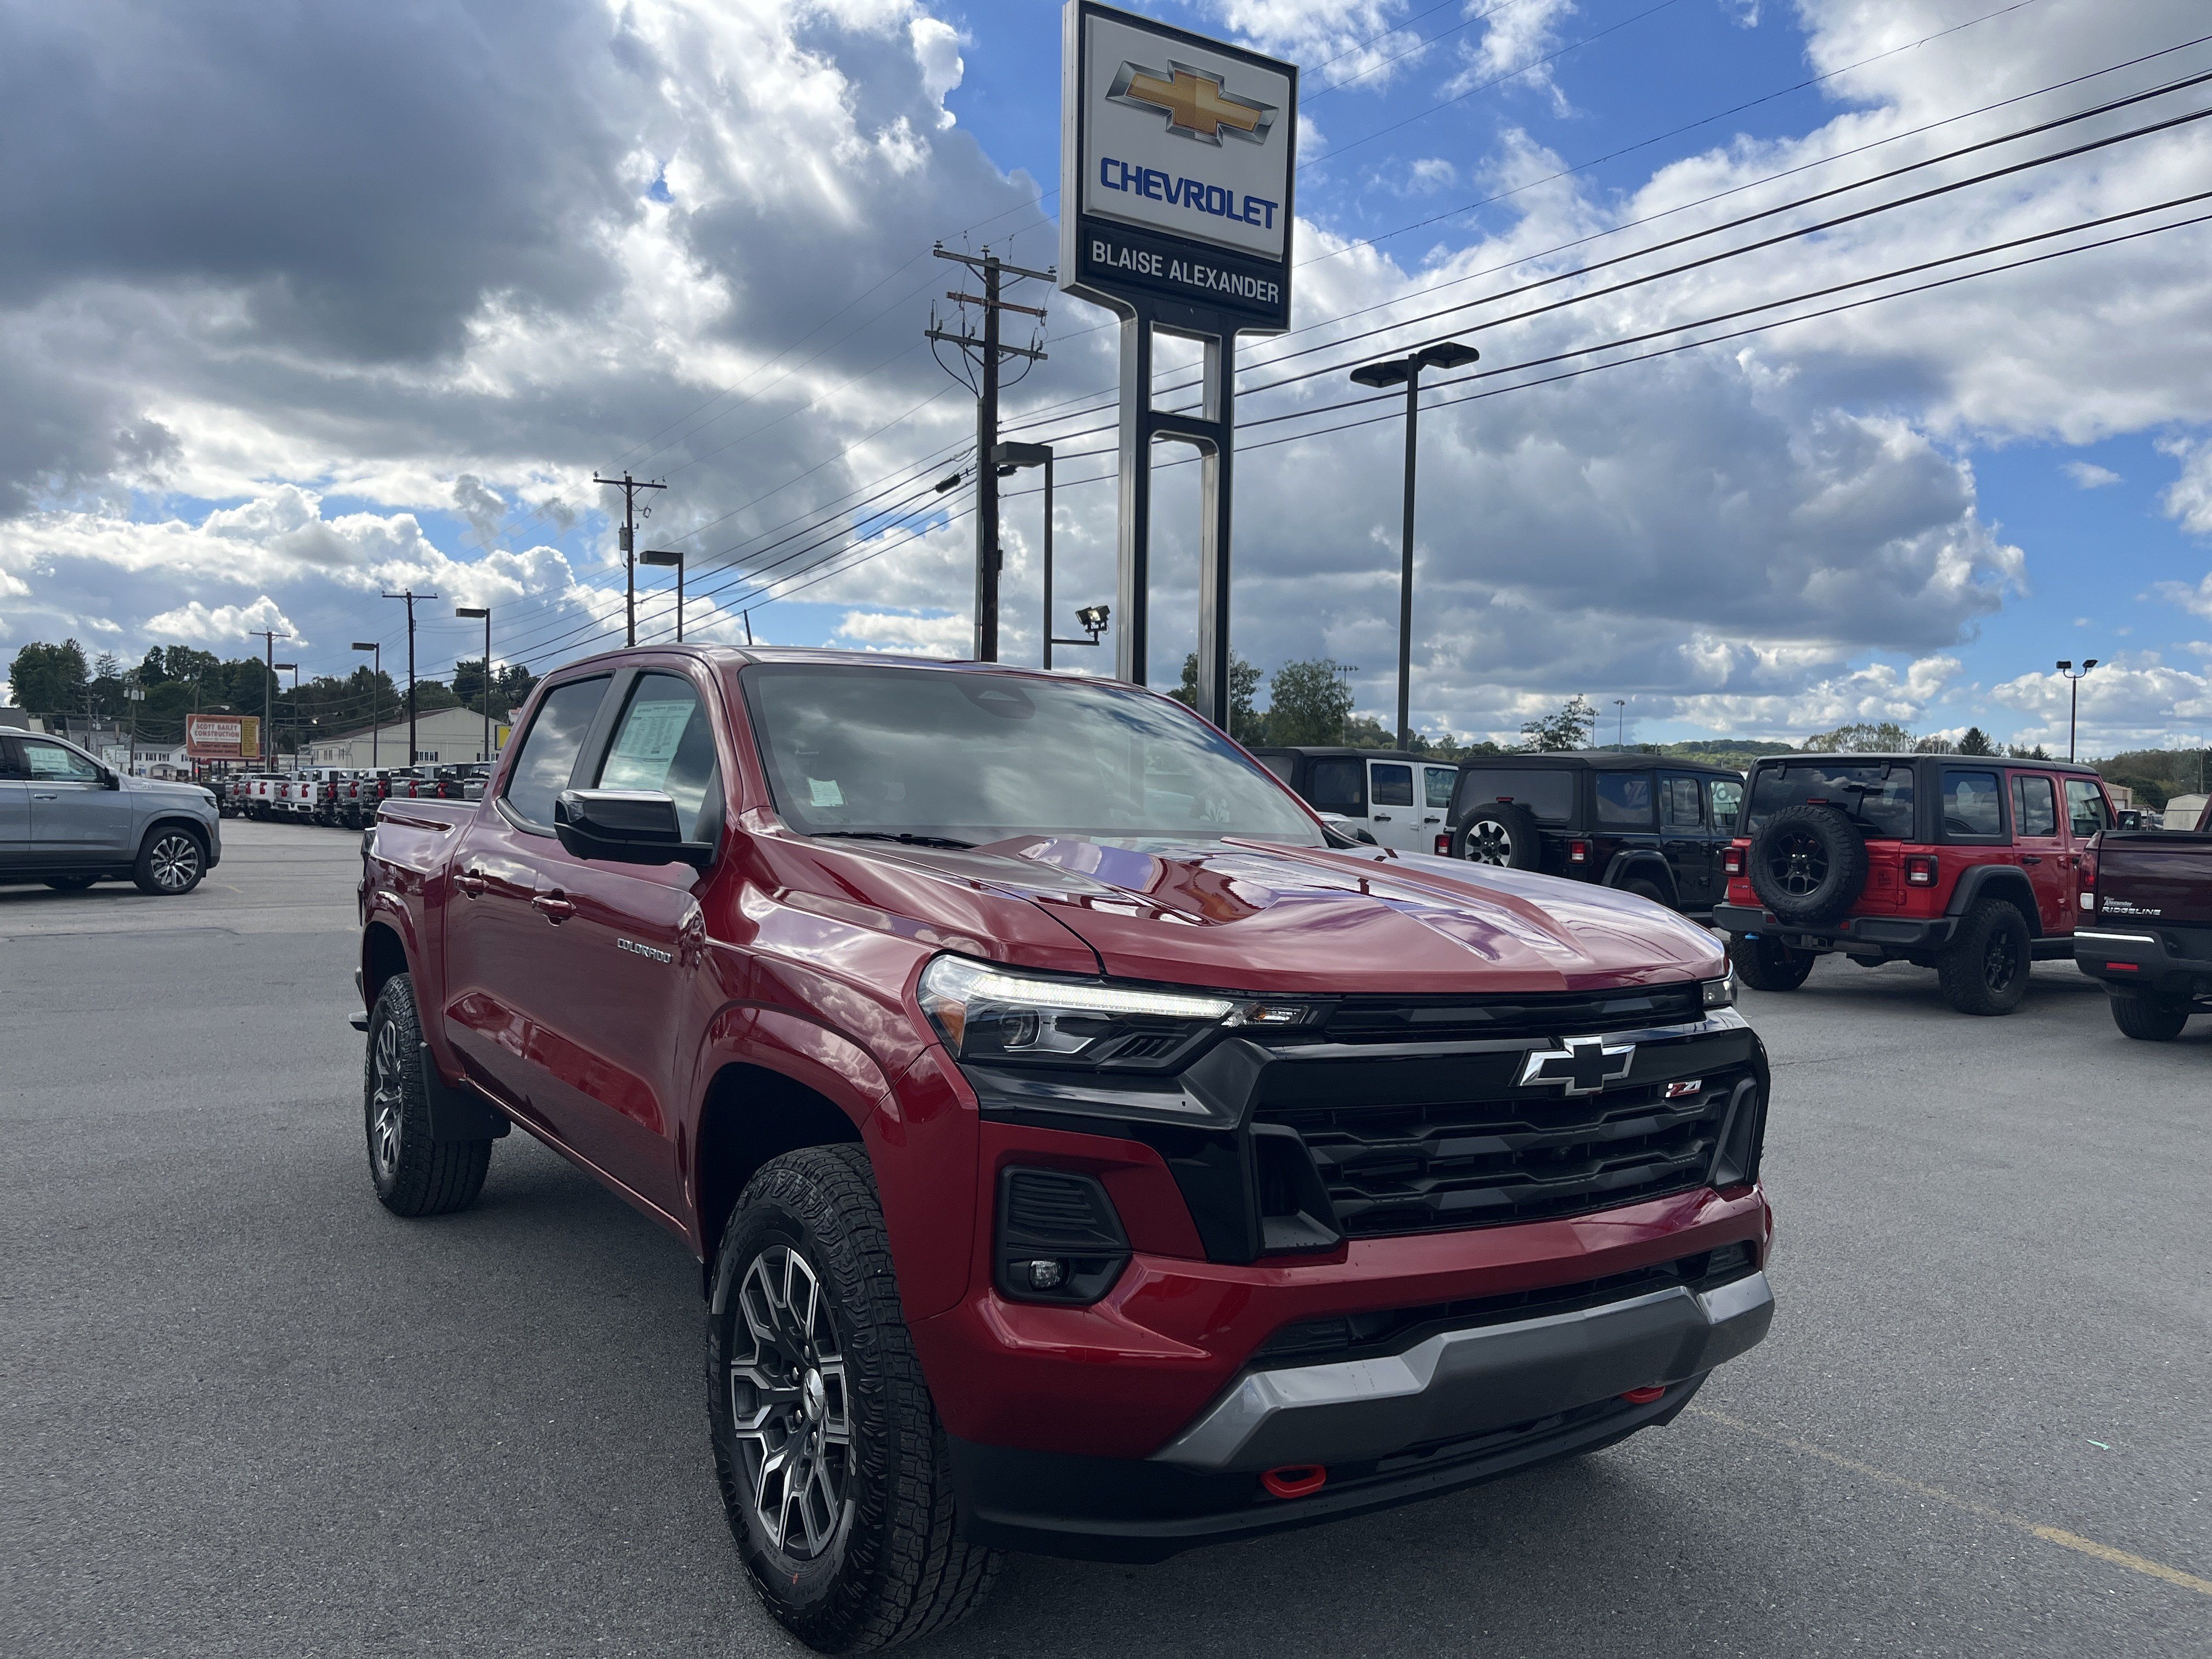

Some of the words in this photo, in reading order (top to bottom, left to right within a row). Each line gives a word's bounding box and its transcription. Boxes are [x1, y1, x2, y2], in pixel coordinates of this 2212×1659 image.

[1101, 157, 1278, 229] CHEVROLET
[1092, 240, 1163, 276] BLAISE
[1169, 260, 1279, 304] ALEXANDER
[2102, 907, 2161, 915] RIDGELINE
[617, 938, 672, 964] COLORADO
[1665, 1080, 1702, 1098] Z71
